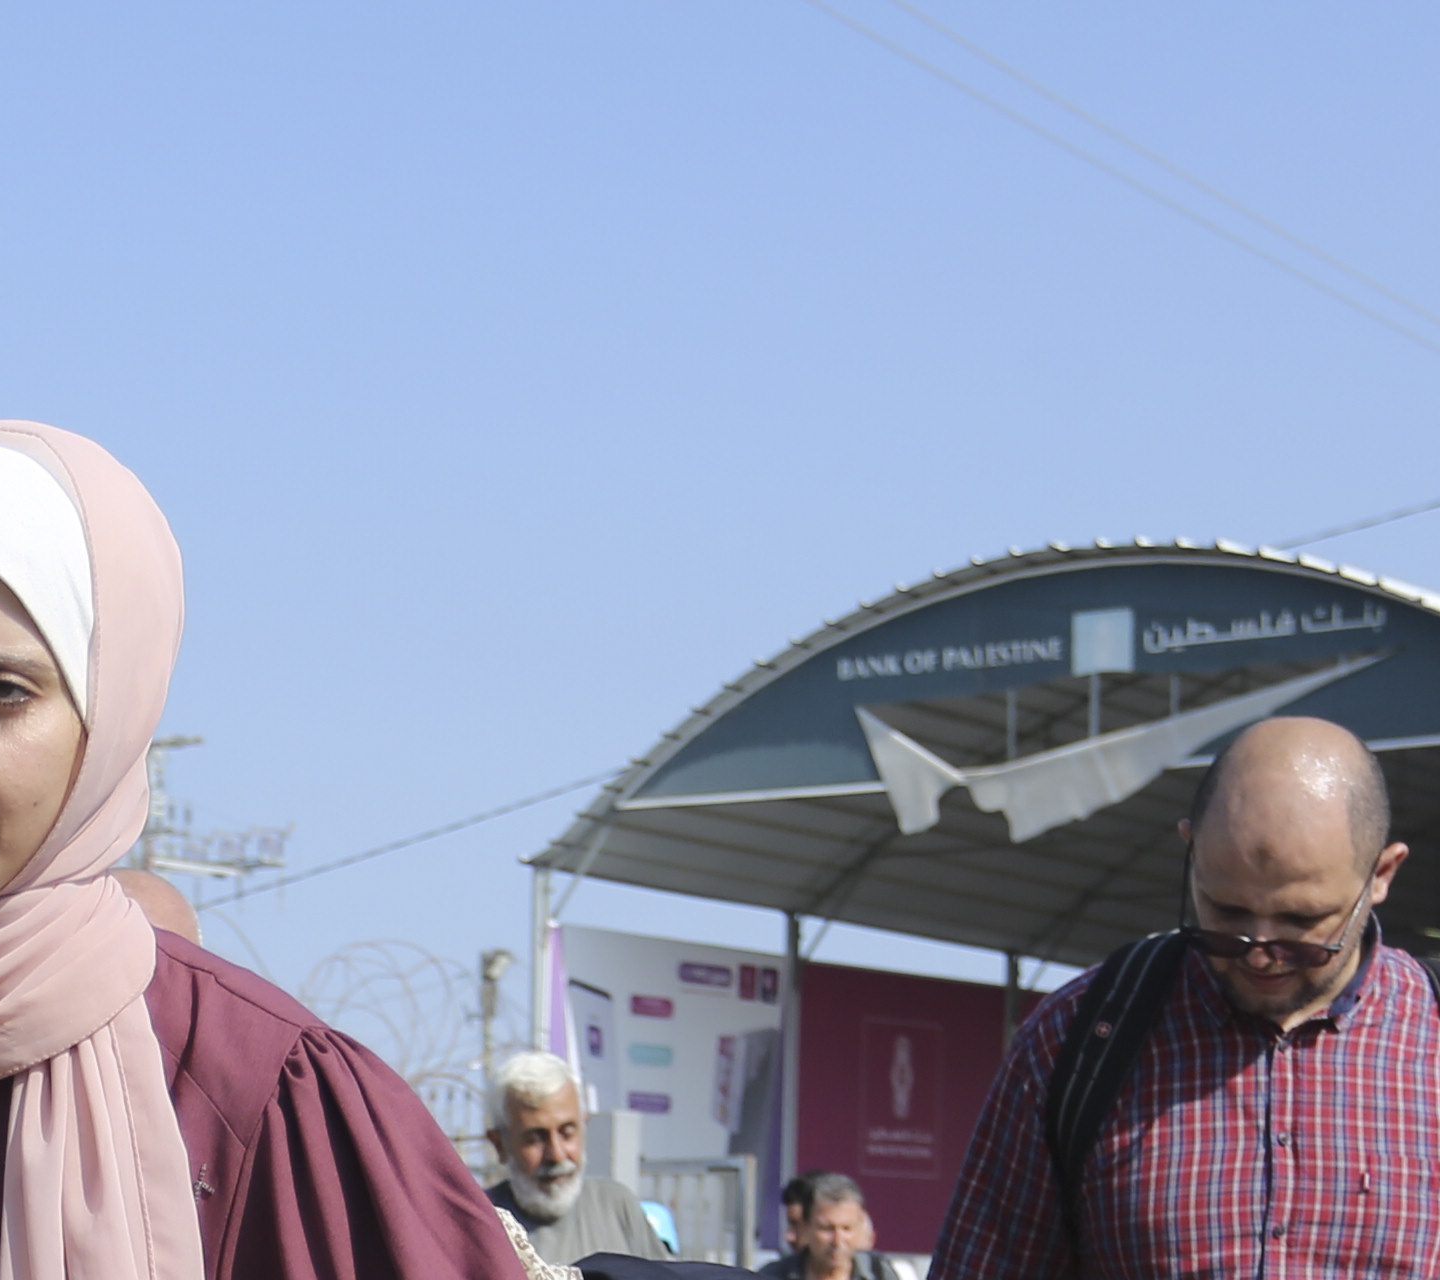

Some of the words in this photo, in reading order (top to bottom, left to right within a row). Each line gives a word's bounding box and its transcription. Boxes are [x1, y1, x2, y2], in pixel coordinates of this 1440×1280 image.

[1143, 608, 1297, 654] فلسطين
[1300, 602, 1388, 633] بنك
[837, 653, 902, 681] BANK
[903, 649, 938, 674] OF
[942, 635, 1062, 671] PALESTINE
